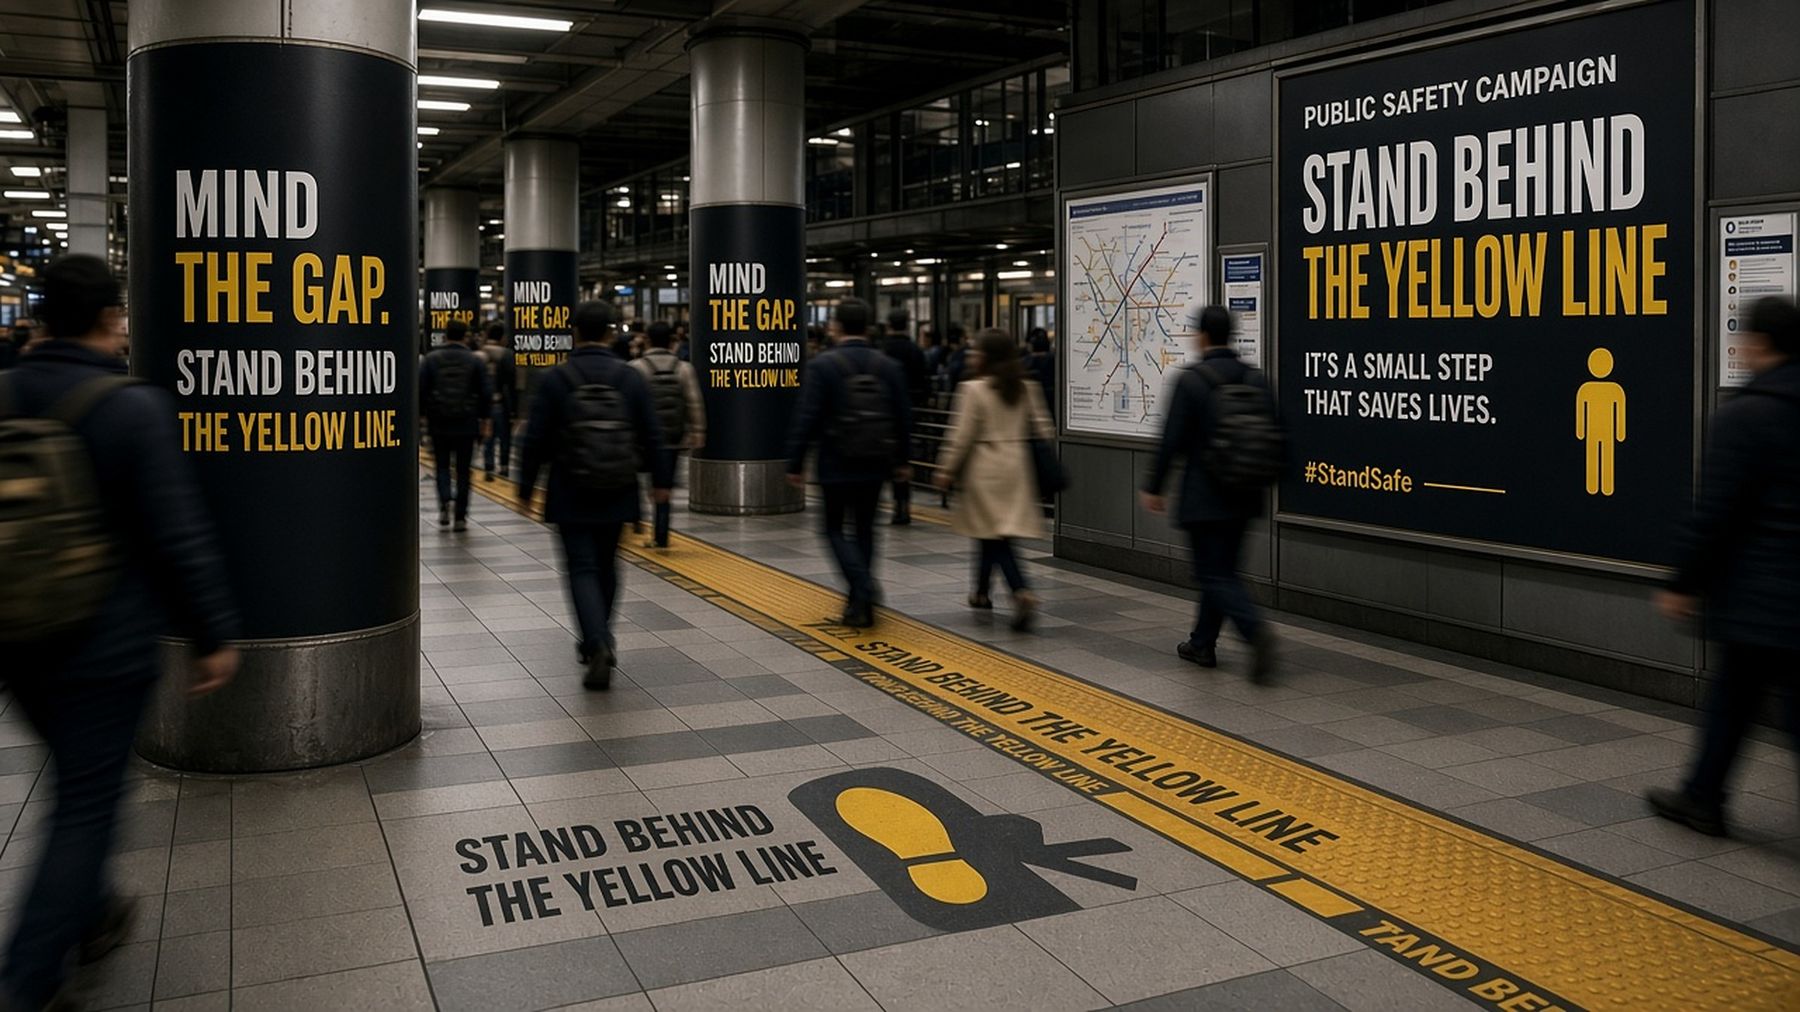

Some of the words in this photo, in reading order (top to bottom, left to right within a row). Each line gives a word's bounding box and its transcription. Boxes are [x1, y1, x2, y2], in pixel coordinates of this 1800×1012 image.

[1304, 95, 1376, 129] PUBLIC
[1382, 79, 1468, 117] SAFETY
[1475, 54, 1617, 103] CAMPAIGN
[1302, 140, 1438, 234] STAND
[1453, 113, 1645, 222] BEHIND
[176, 169, 319, 239] MIND
[175, 252, 273, 323] THE
[292, 252, 389, 324] GAP.
[514, 281, 551, 304] MIND
[709, 262, 766, 295] MIND
[1302, 243, 1370, 319] THE
[1380, 231, 1548, 318] YELLOW
[1562, 223, 1668, 316] LINE
[430, 291, 459, 309] MIND
[513, 305, 539, 329] THE
[543, 305, 572, 329] GAP.
[709, 299, 750, 331] THE
[756, 298, 797, 331] GAP.
[177, 349, 282, 396] STAND
[295, 350, 396, 395] BEHIND
[710, 342, 754, 364] STAND
[758, 342, 800, 364] BEHIND
[1304, 352, 1339, 379] IT'S
[1344, 354, 1358, 379] A
[1364, 354, 1431, 380] SMALL
[1438, 353, 1493, 382] STEP
[709, 369, 731, 388] THE
[733, 368, 779, 388] YELLOW
[1304, 389, 1352, 416] THAT
[1358, 391, 1422, 421] SAVES
[1429, 394, 1497, 425] LIVES.
[178, 412, 229, 451] THE
[238, 411, 347, 451] YELLOW
[354, 410, 400, 448] LINE.
[1304, 460, 1413, 493] #StandSafe
[855, 641, 945, 674] STAND
[923, 672, 1034, 715] BEHIND
[1017, 710, 1100, 744] THE
[1080, 737, 1240, 805] YELLOW
[1214, 800, 1341, 854] LINE
[985, 733, 1067, 770] YELLOW
[1051, 768, 1111, 793] LINE
[454, 824, 608, 875] STAND
[613, 804, 775, 853] BEHIND
[466, 876, 562, 927] THE
[562, 852, 736, 912] YELLOW
[736, 840, 838, 886] LINE
[1358, 919, 1480, 981] TAND
[1467, 977, 1570, 1012] BE
